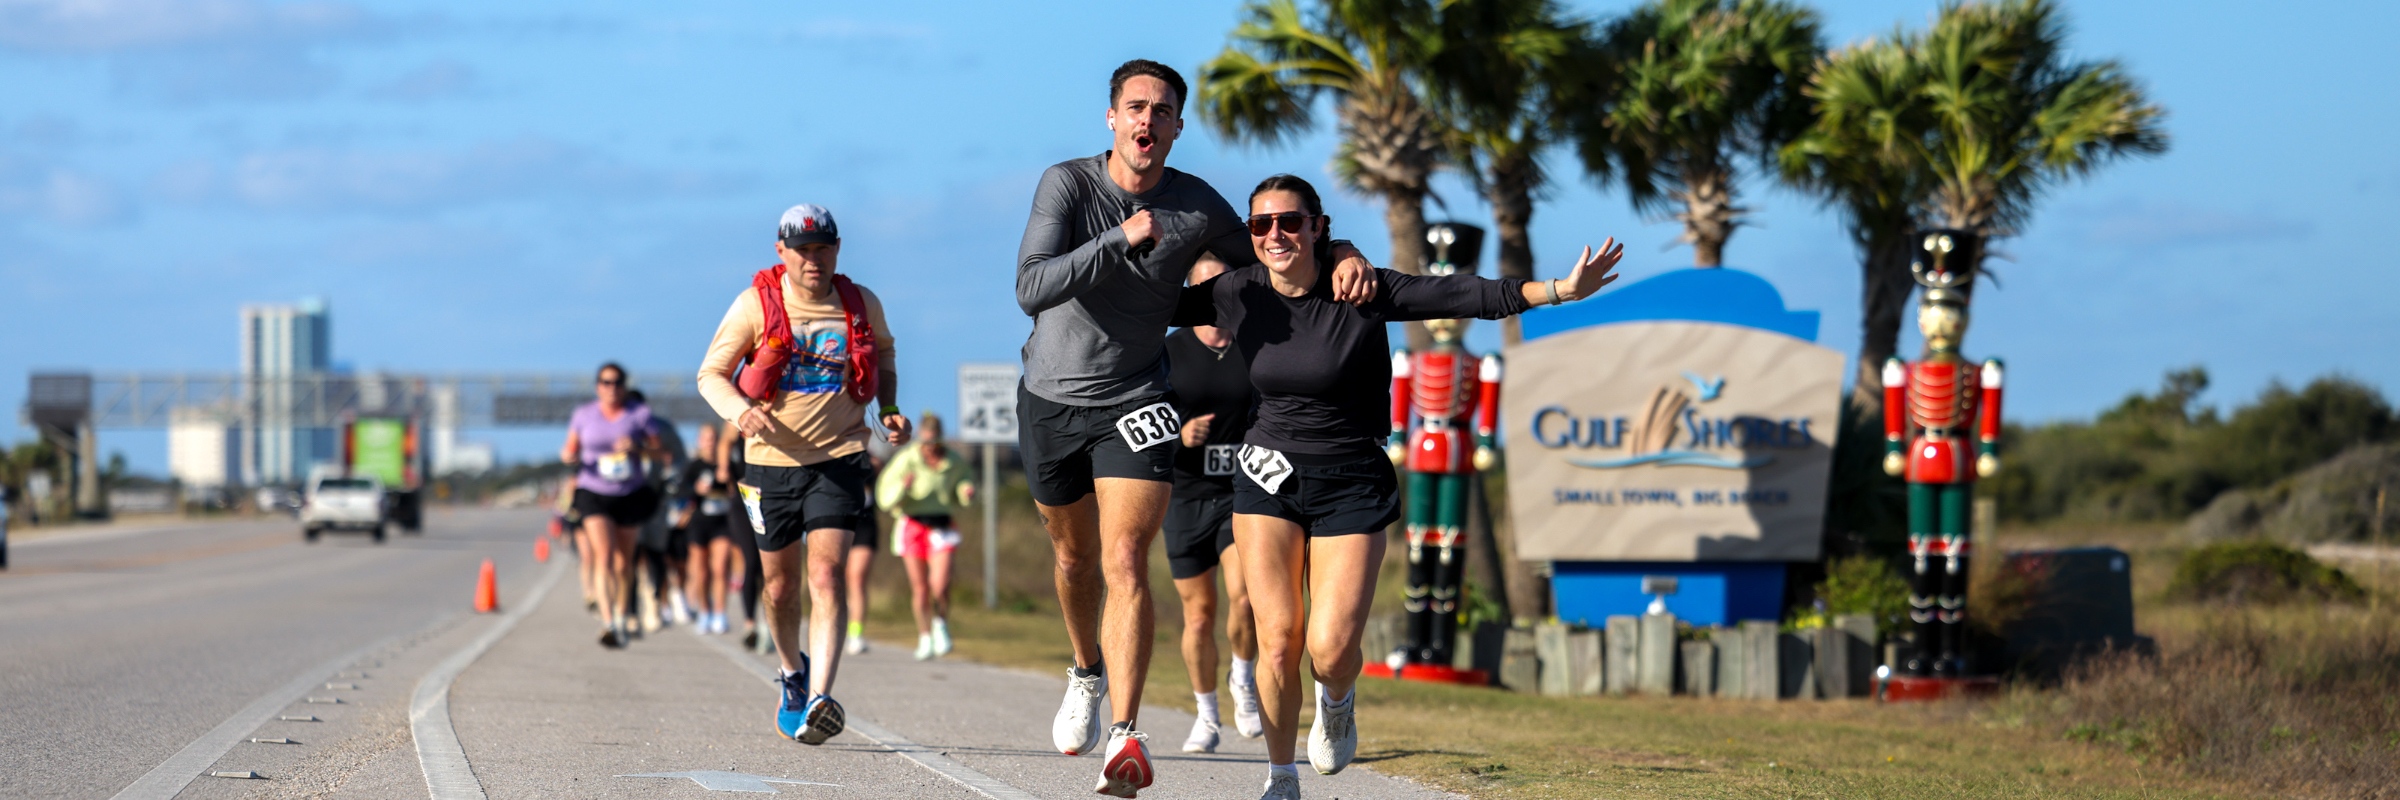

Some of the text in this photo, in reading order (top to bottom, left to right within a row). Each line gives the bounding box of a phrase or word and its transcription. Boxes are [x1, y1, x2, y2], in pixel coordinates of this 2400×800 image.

[965, 406, 1015, 433] 45
[1123, 406, 1179, 446] 638
[1531, 405, 1813, 449] GULF SHORES
[1208, 448, 1233, 472] 63
[1554, 488, 1613, 505] SMALL
[1621, 488, 1682, 507] TOWN,
[1693, 488, 1723, 505] BIG
